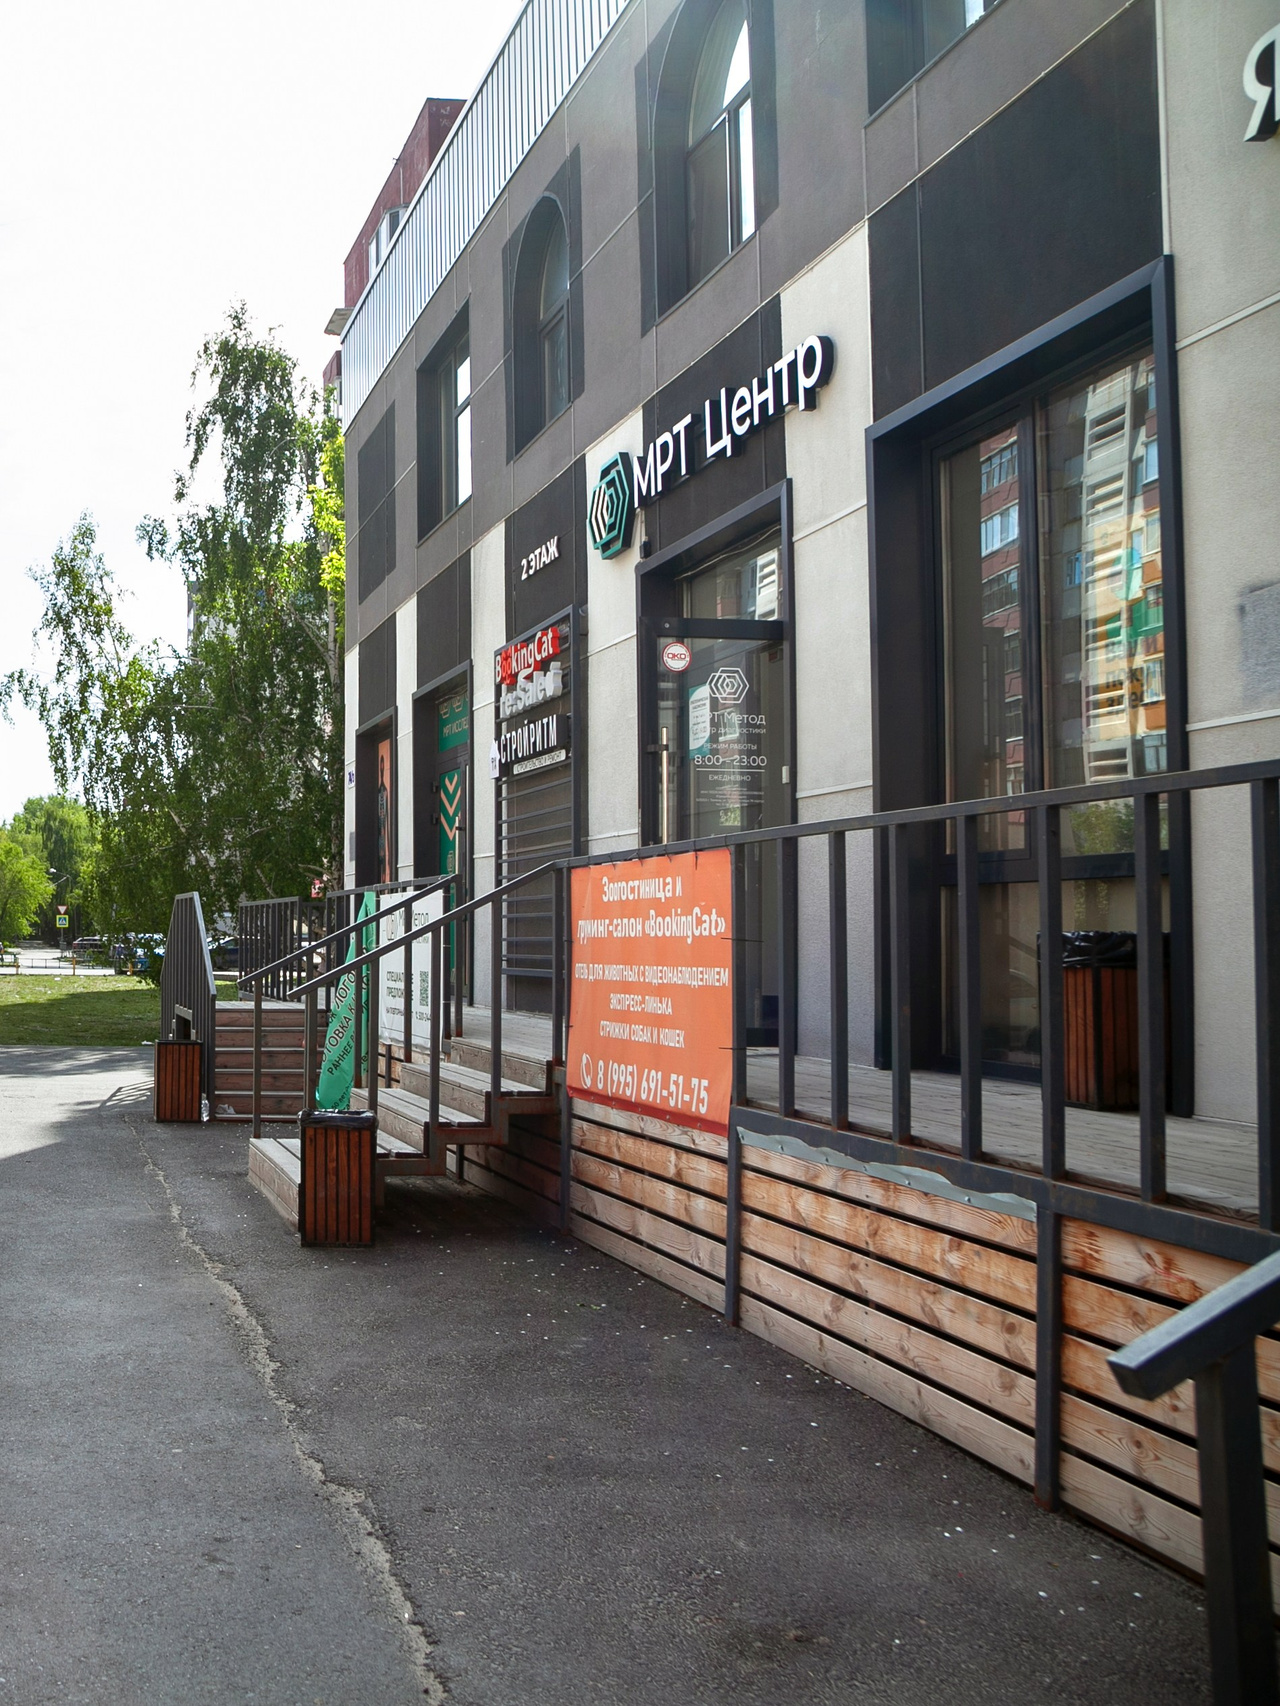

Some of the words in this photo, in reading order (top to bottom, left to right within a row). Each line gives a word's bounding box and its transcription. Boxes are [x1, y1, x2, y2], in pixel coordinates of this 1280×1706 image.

[633, 413, 692, 508] МРТ
[705, 335, 822, 458] Центр
[521, 558, 528, 581] 2
[528, 535, 559, 576] ЭТАЖ
[496, 627, 554, 683] BookingCat
[724, 713, 766, 725] Метод
[501, 714, 557, 764] СТРОЙРИТМ
[694, 755, 722, 766] 8:00
[733, 755, 767, 766] 23:00
[602, 876, 673, 902] Зоогостиница
[577, 917, 643, 944] груминг-салон
[645, 907, 726, 944] «BookingCat»
[575, 963, 588, 979] ОТЕЛЬ
[588, 964, 603, 982] ДЛЯ
[603, 964, 639, 983] ЖИВОТНЫХ
[639, 965, 644, 982] С
[645, 965, 729, 988] ВИДЕОНАБЛЮДЕНИЕМ
[610, 993, 673, 1015] ЭКСПРЕСС-ЛИНЬКА
[600, 1020, 630, 1040] СТРИЖКИ
[631, 1024, 652, 1043] СОБАК
[652, 1026, 658, 1044] И
[659, 1027, 685, 1048] КОШЕК
[597, 1059, 604, 1090] 8
[608, 1059, 637, 1103] (995)
[640, 1068, 709, 1114] 691-51-75
